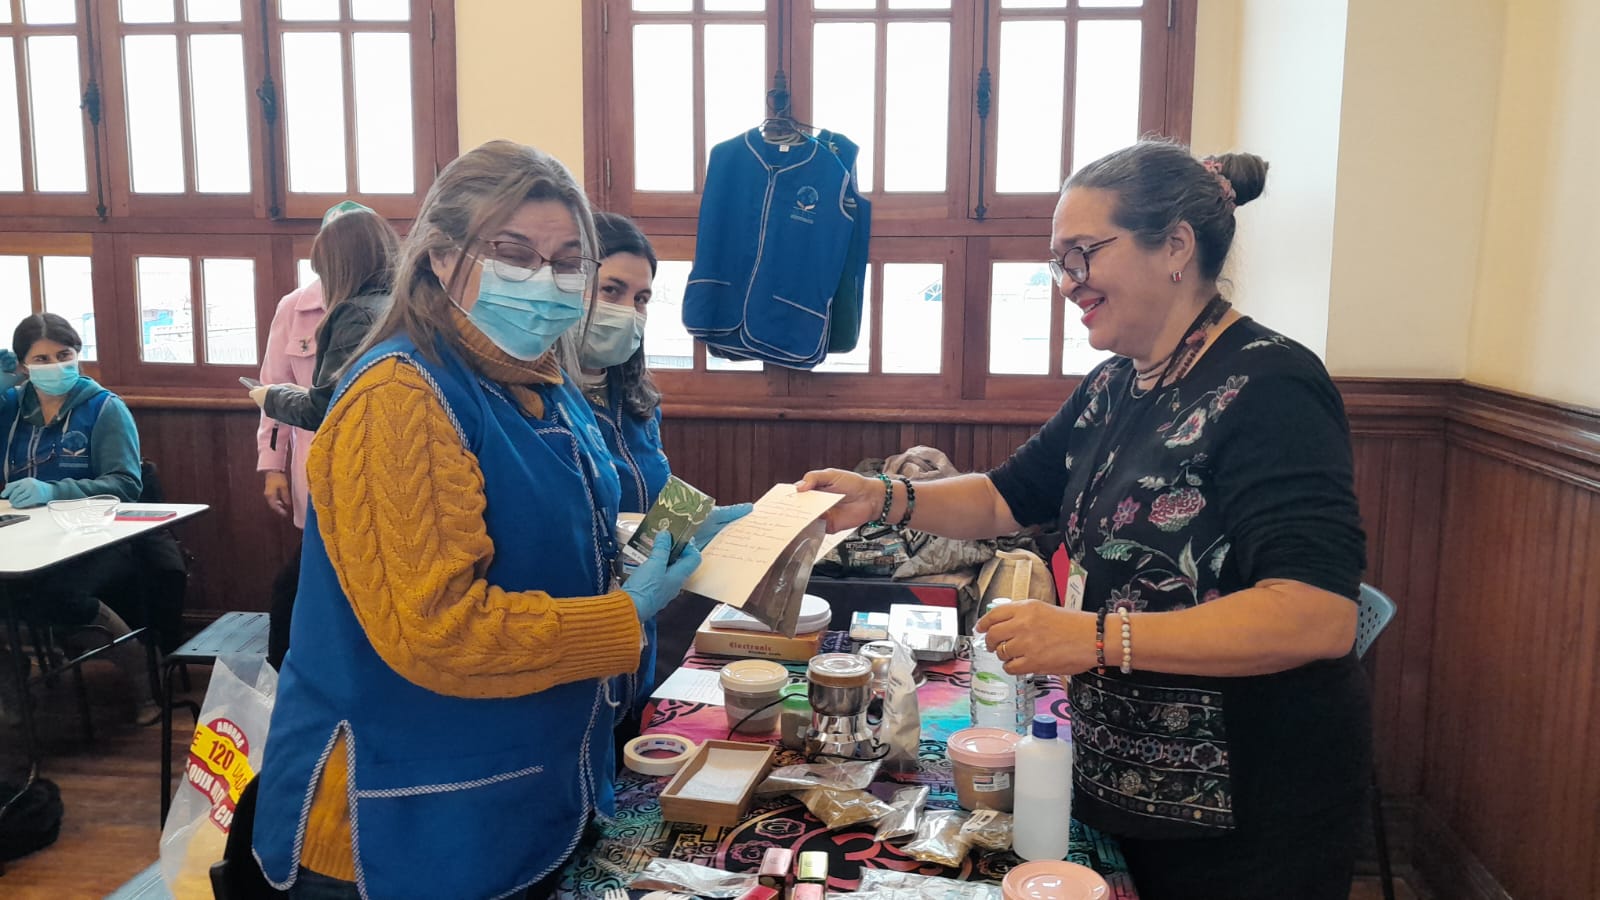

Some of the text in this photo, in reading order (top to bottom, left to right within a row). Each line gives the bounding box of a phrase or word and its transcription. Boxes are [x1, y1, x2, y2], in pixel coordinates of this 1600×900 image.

[729, 642, 772, 652] Electronic
[216, 721, 245, 749] AHORRA
[208, 740, 235, 770] 120
[188, 763, 214, 791] QUIX
